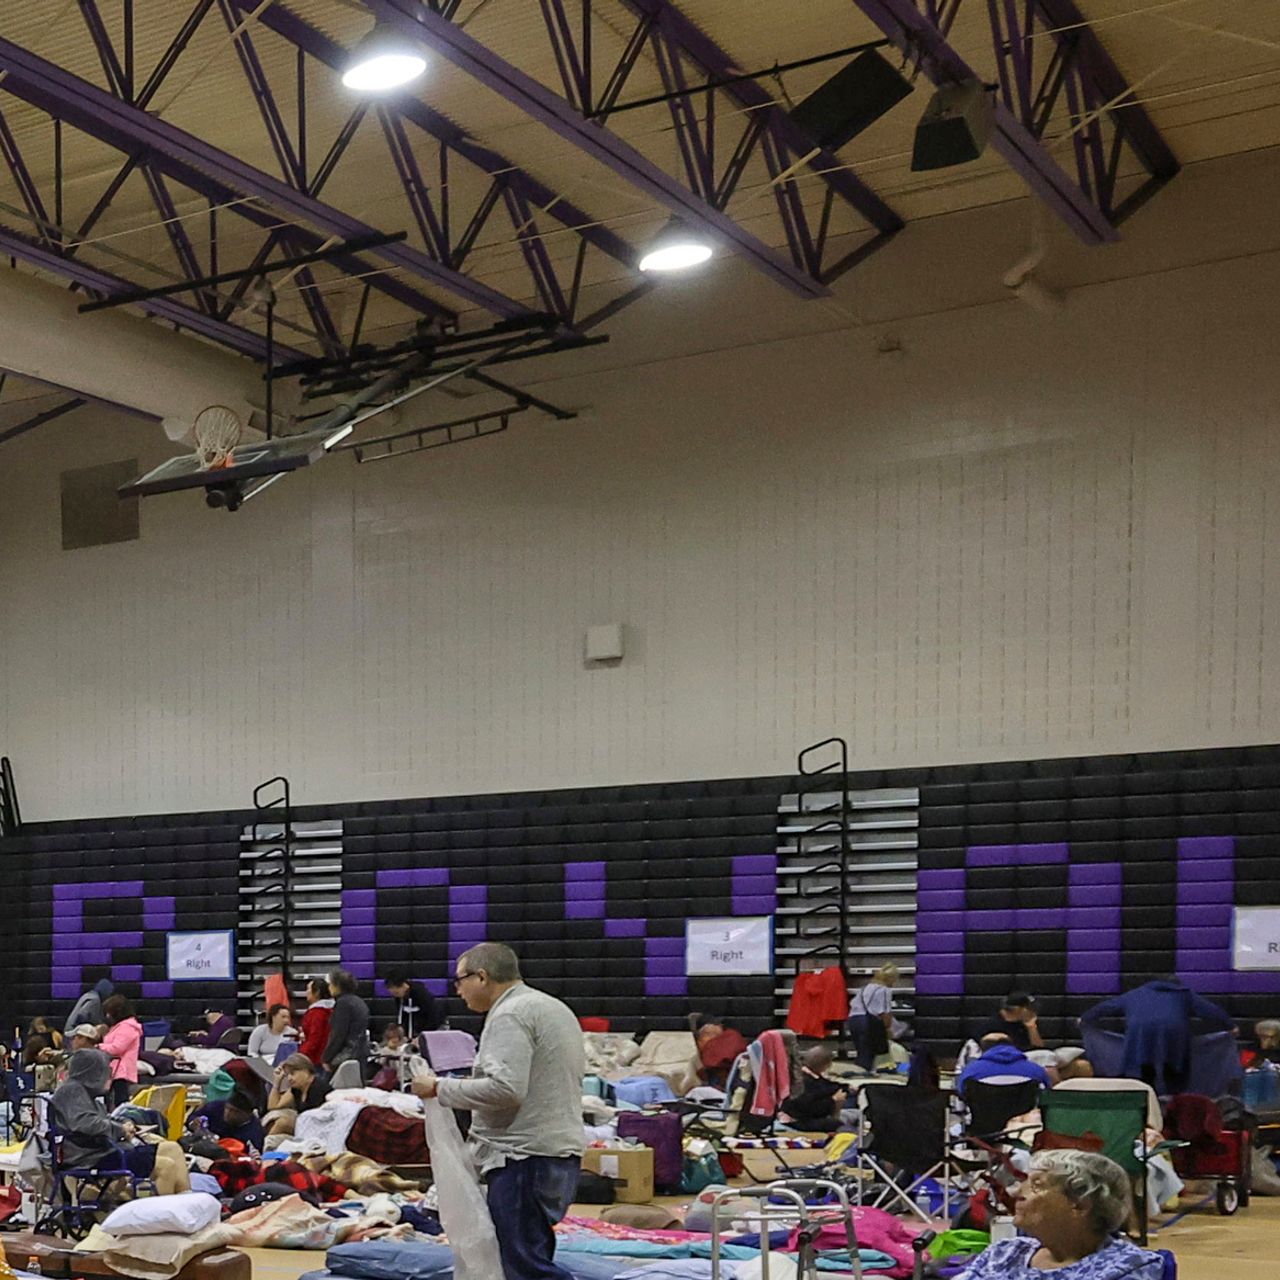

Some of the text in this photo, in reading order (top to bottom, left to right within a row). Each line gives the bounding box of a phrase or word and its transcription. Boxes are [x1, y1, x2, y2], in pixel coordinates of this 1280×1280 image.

[723, 931, 730, 941] 3
[195, 943, 202, 951] 4
[711, 950, 744, 962] Right
[186, 960, 211, 970] Right
